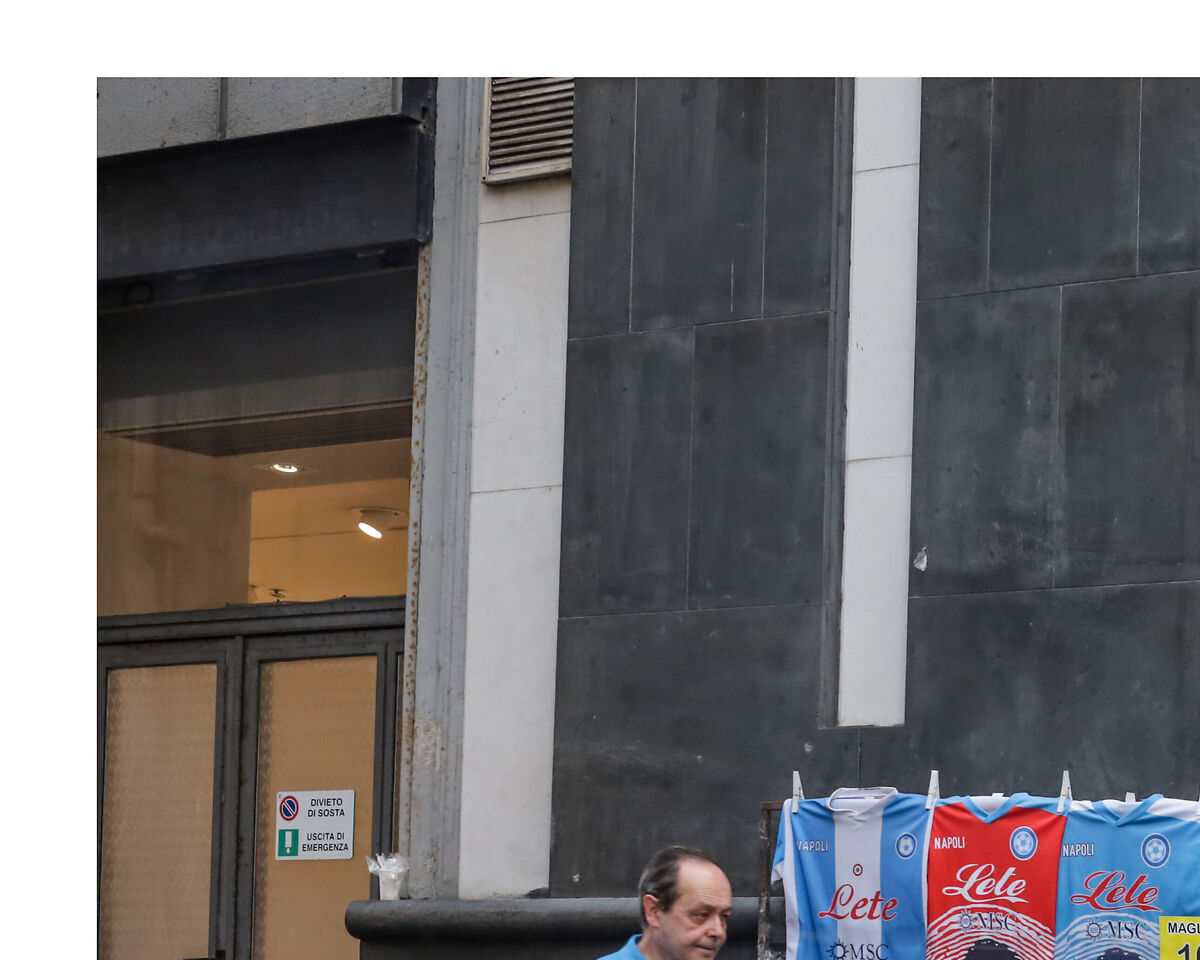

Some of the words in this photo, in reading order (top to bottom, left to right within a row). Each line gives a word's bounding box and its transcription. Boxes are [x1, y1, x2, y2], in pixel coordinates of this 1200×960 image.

[311, 798, 343, 807] DIVIETO
[307, 809, 316, 818] DI
[318, 809, 345, 818] SOSTA
[306, 832, 335, 841] USCITA
[336, 832, 345, 840] DI
[934, 836, 966, 850] NAPOLI
[302, 843, 349, 852] EMERGENZA
[1062, 843, 1095, 857] NAPOLI
[942, 863, 1030, 904] Lete
[1070, 870, 1163, 913] Lete
[818, 883, 899, 921] Lete
[977, 912, 1020, 932] MSC
[1108, 920, 1148, 941] MSC
[850, 943, 889, 960] MSC
